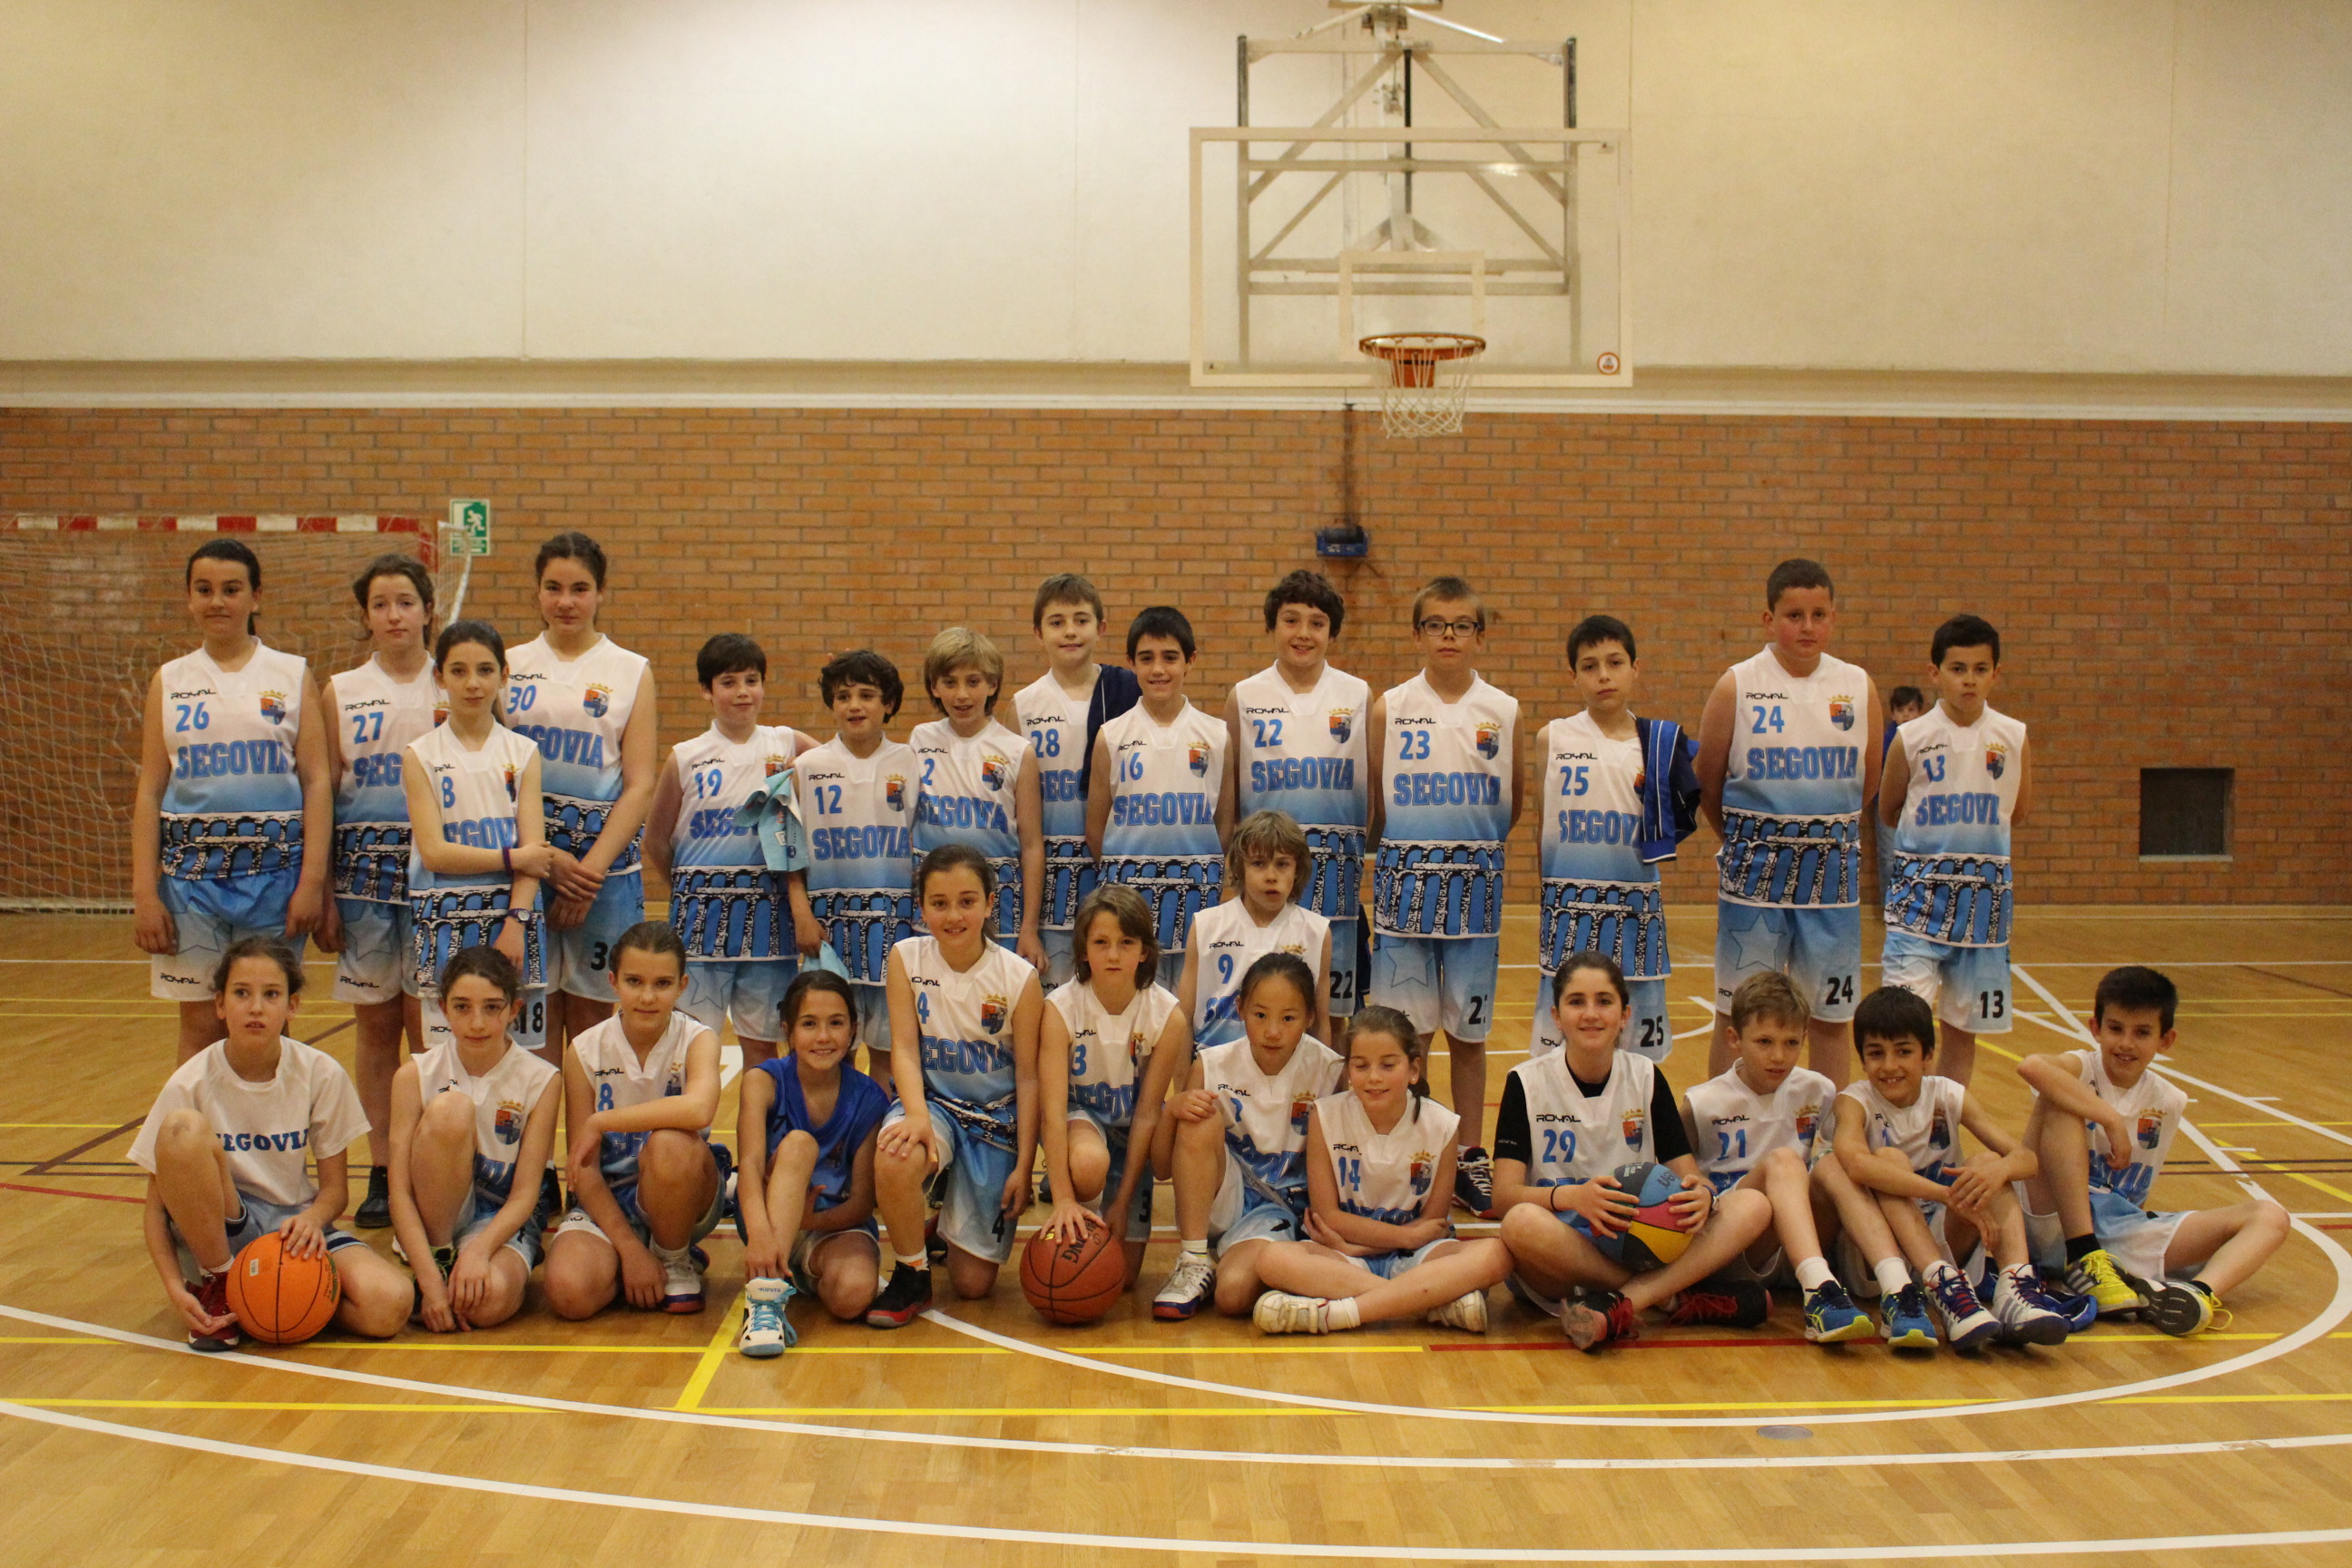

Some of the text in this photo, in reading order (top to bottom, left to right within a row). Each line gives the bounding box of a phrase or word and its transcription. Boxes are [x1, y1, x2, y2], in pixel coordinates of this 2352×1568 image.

[171, 689, 217, 700] ROYAL
[345, 699, 391, 710] ROYAL
[507, 685, 536, 714] 30
[175, 701, 210, 732] 26
[1026, 715, 1065, 726] ROYAL
[1246, 707, 1289, 715] ROYAL
[1752, 705, 1785, 733] 24
[352, 711, 384, 744] 27
[1252, 719, 1283, 748] 22
[1031, 729, 1060, 759] 28
[1399, 730, 1430, 760] 23
[1555, 752, 1598, 760] ROYAL
[808, 772, 845, 780] ROYAL
[921, 758, 936, 786] 2
[1120, 752, 1143, 782] 16
[1251, 757, 1354, 793] SEGOVIA
[1747, 746, 1858, 780] SEGOVIA
[1923, 754, 1945, 782] 13
[695, 769, 722, 799] 19
[1560, 766, 1589, 796] 25
[815, 785, 842, 815] 12
[812, 825, 911, 861] SEGOVIA
[1210, 941, 1244, 949] ROYAL
[1218, 954, 1234, 985] 9
[1330, 970, 1353, 999] 22
[1825, 975, 1854, 1005] 24
[1979, 990, 2004, 1019] 13
[917, 991, 930, 1024] 4
[1640, 1015, 1664, 1048] 25
[1072, 1044, 1087, 1076] 3
[1536, 1114, 1581, 1123] ROYAL
[1712, 1114, 1749, 1125] ROYAL
[216, 1128, 309, 1152] EGOVI
[1543, 1129, 1576, 1163] 29
[1338, 1156, 1361, 1191] 14
